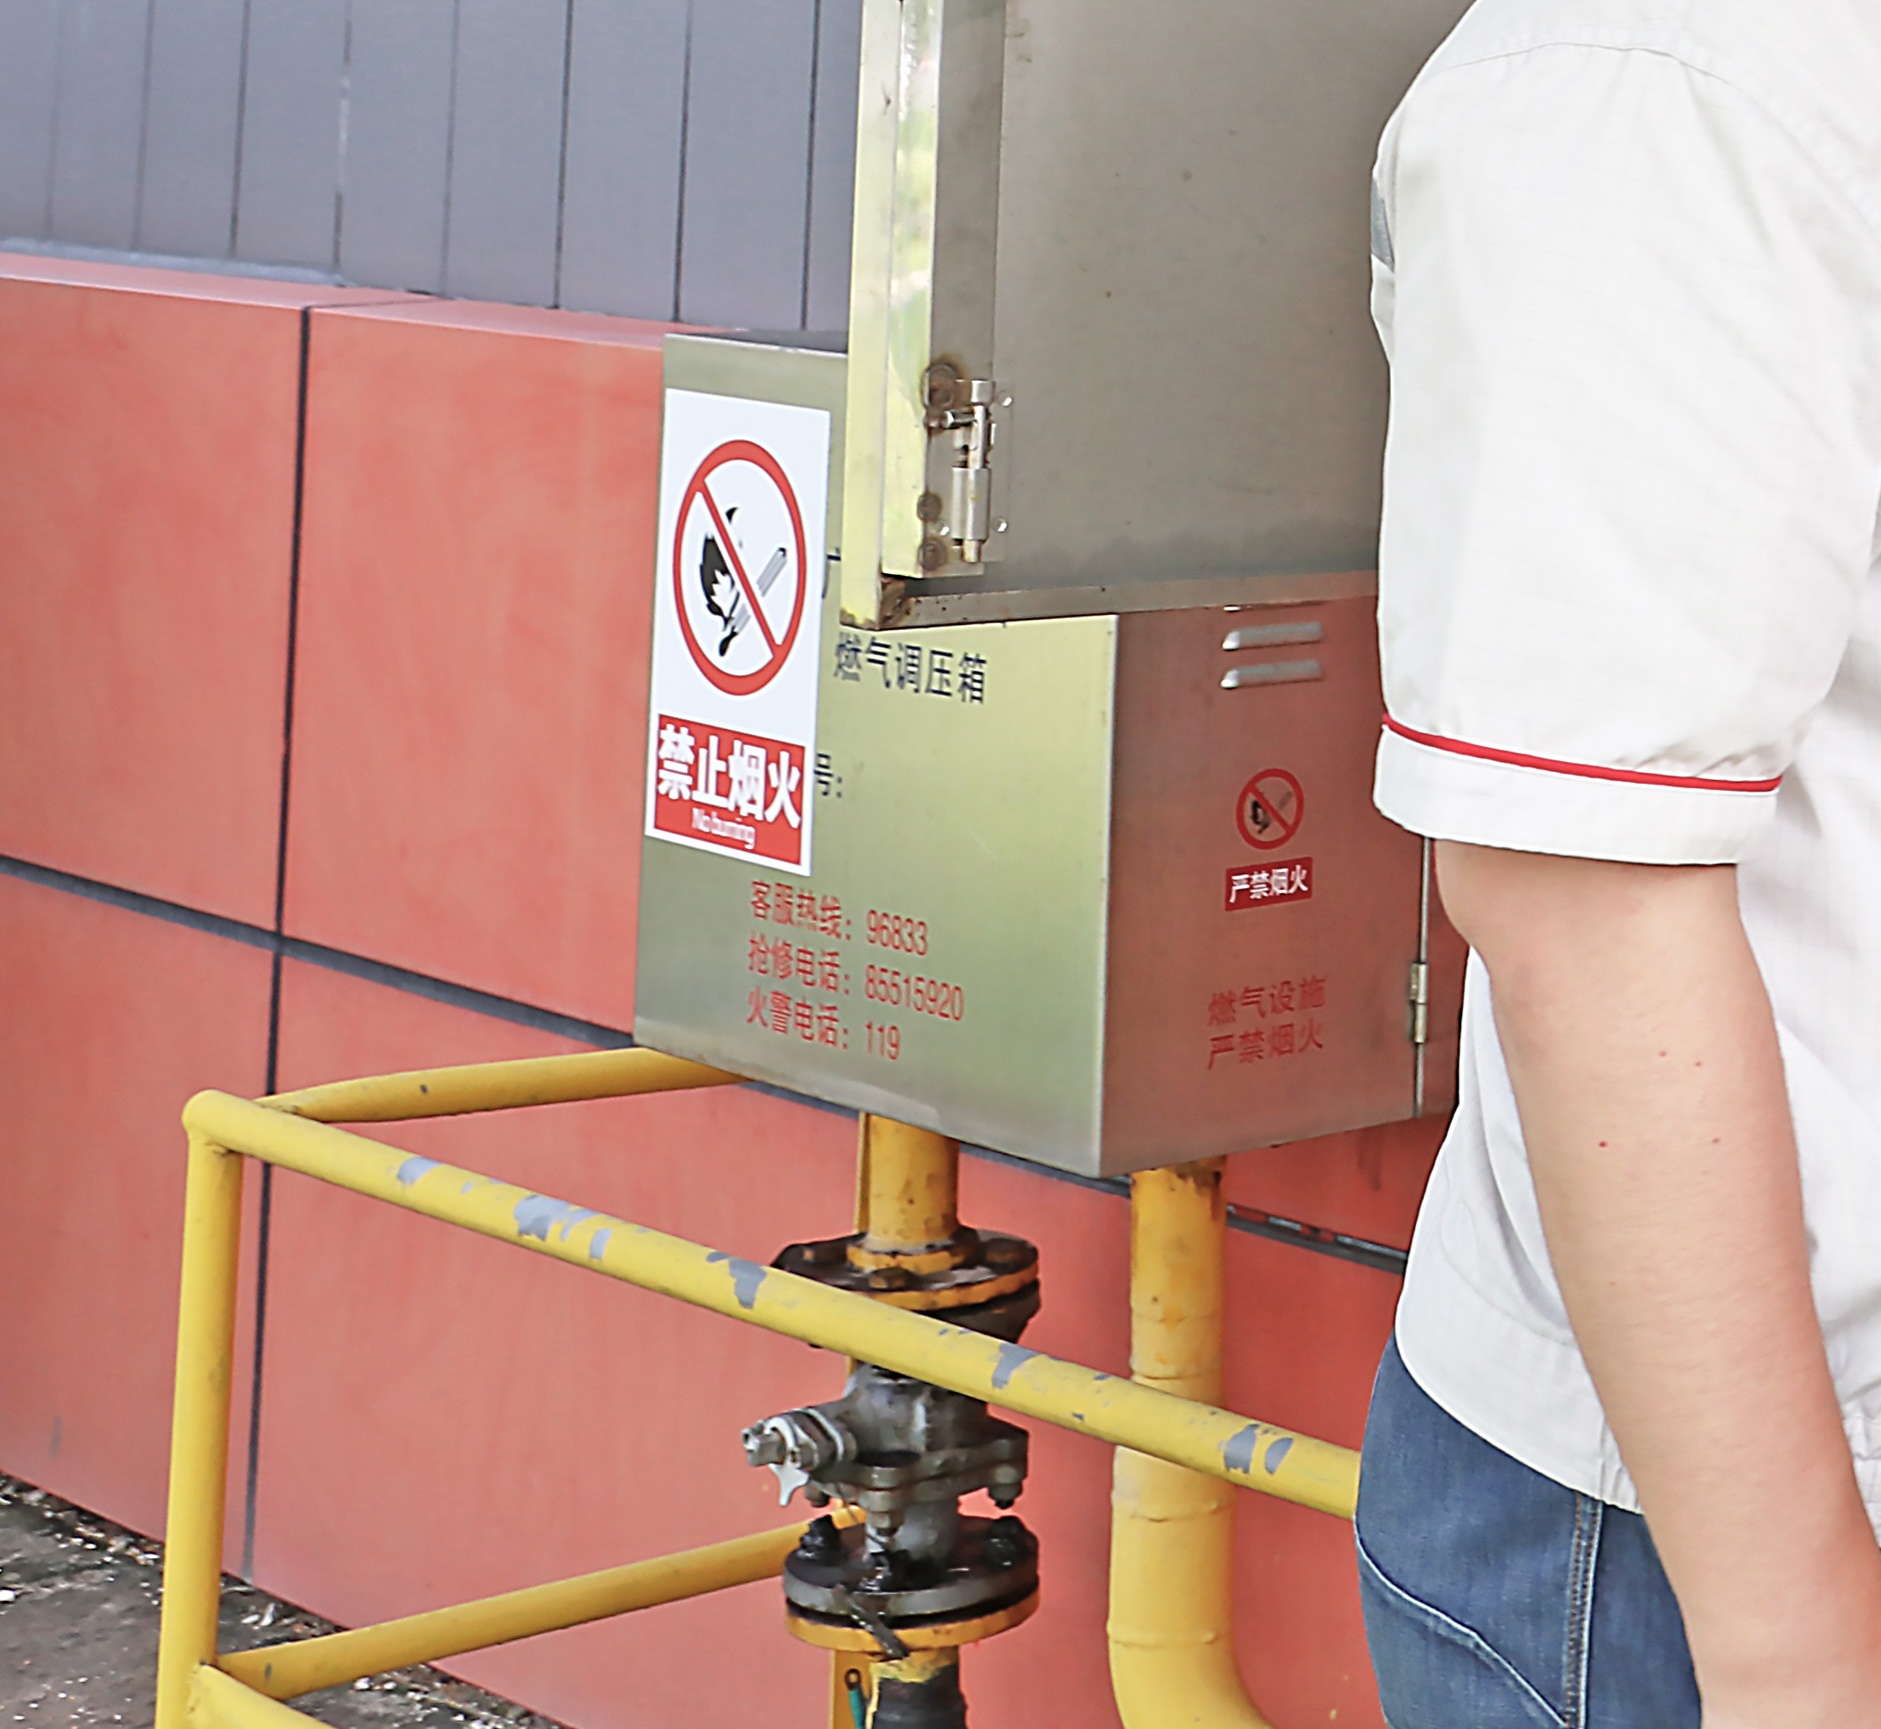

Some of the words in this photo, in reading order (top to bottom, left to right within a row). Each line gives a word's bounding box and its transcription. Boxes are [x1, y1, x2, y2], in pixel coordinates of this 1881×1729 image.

[833, 631, 988, 704] 燃气调压箱
[657, 723, 801, 829] 禁止烟火
[1229, 864, 1309, 904] 严禁烟火
[866, 909, 929, 956] 96833
[864, 963, 964, 1022] 85515920
[1207, 975, 1326, 1027] 燃气设施
[865, 1021, 901, 1061] 119
[1207, 1017, 1324, 1071] 严禁烟火
